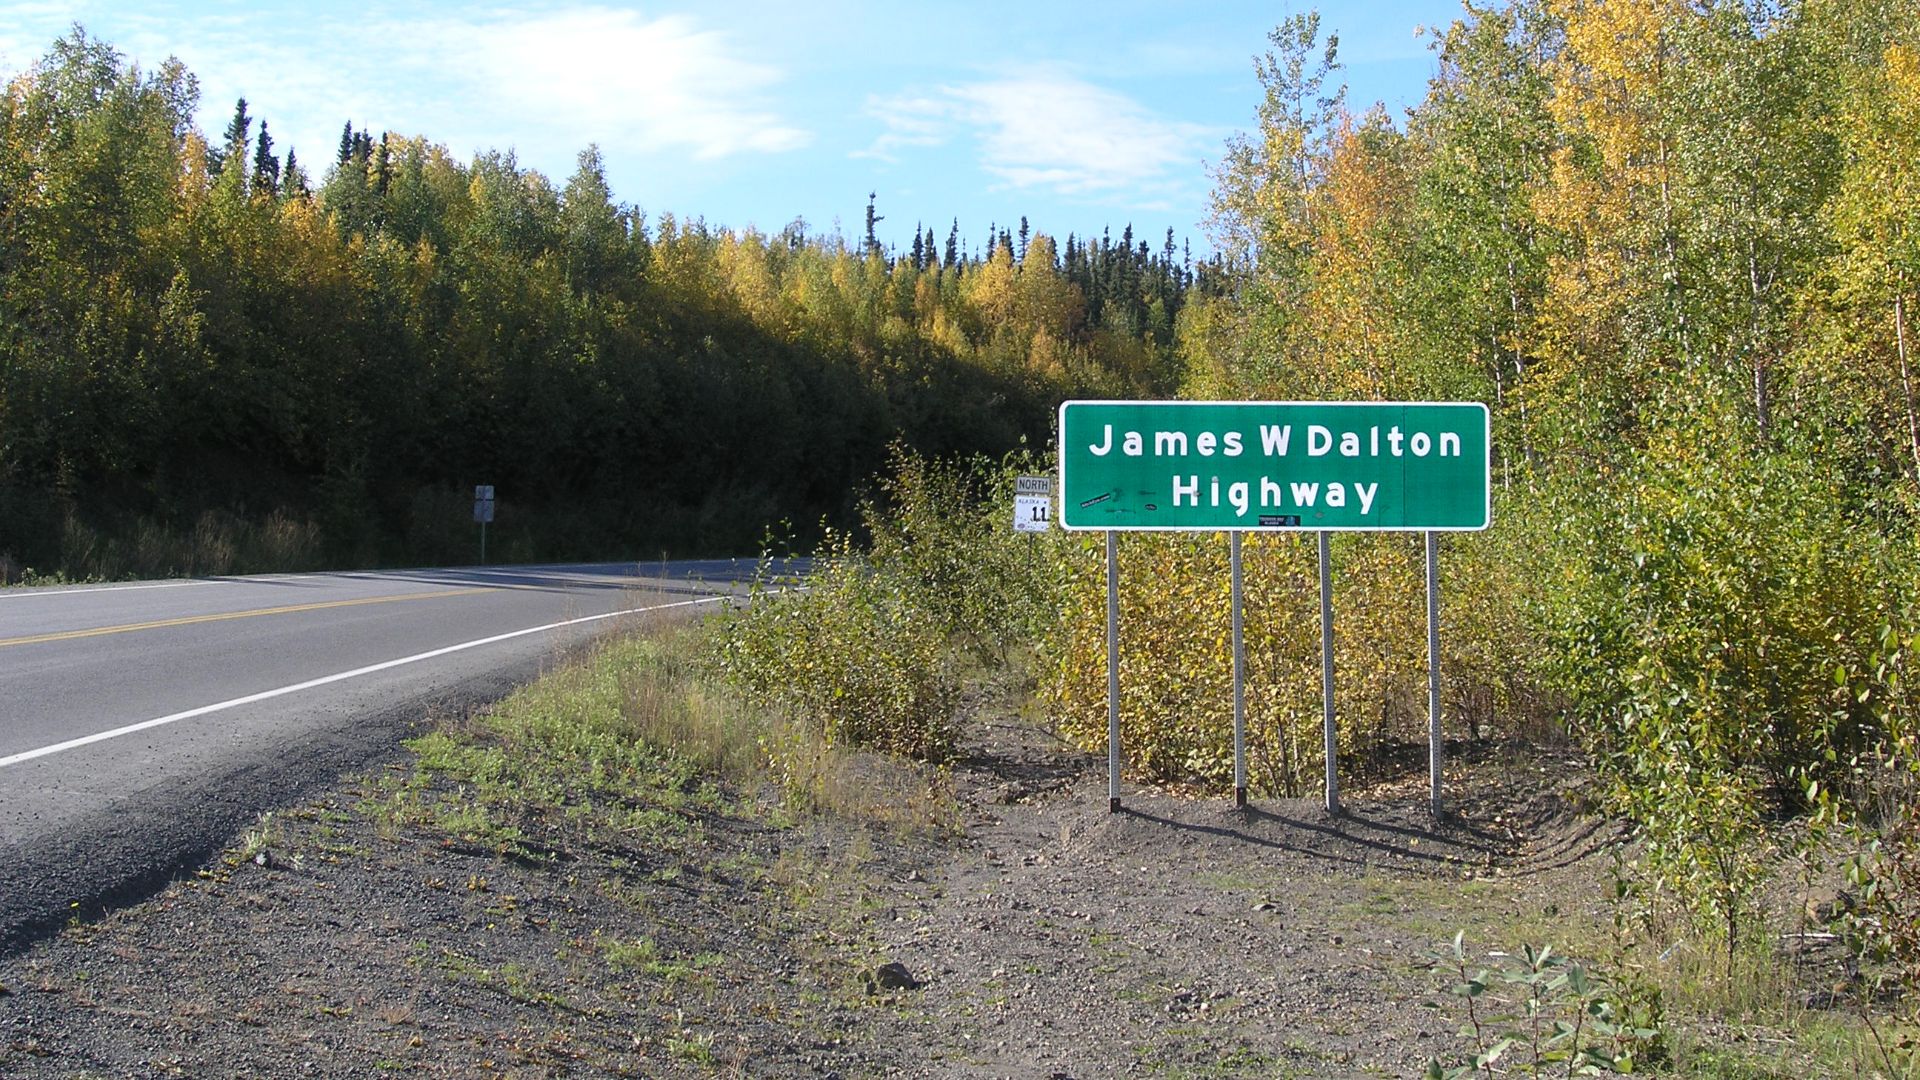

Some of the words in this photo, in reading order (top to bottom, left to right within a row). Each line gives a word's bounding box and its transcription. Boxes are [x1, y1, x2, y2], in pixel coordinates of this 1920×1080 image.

[1089, 424, 1244, 457] James
[1259, 425, 1292, 456] W
[1307, 425, 1461, 457] Dalton
[1018, 479, 1048, 490] NORTH
[1172, 475, 1379, 517] Highway
[1032, 506, 1047, 522] 11
